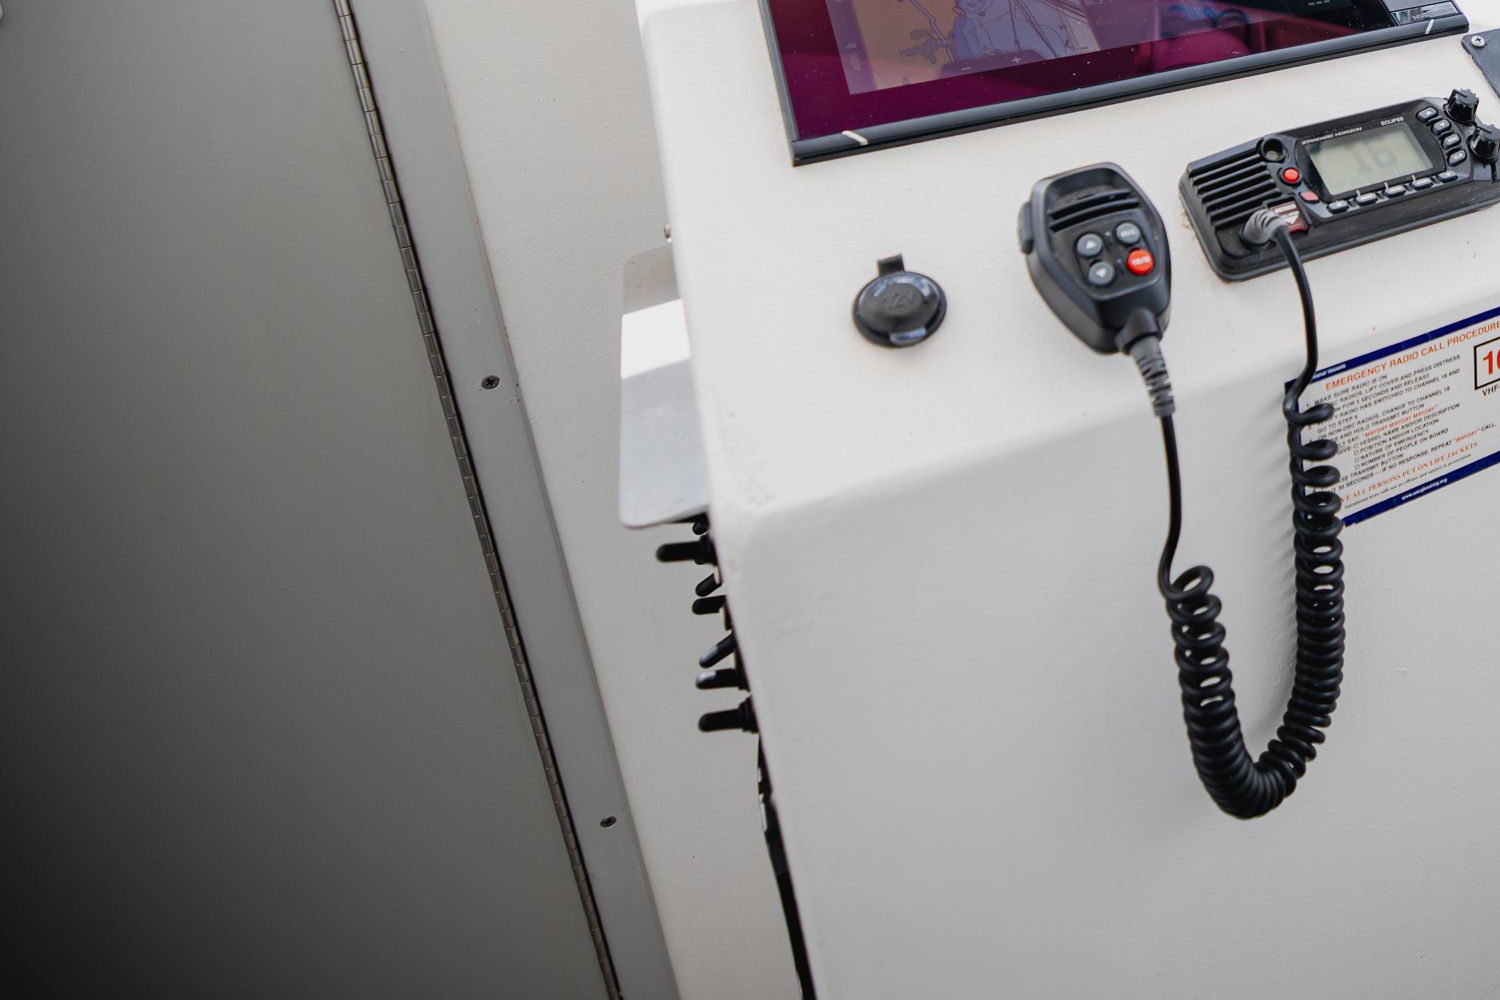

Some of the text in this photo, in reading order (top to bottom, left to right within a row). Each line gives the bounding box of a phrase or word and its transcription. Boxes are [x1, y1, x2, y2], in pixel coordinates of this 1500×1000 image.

[1301, 126, 1363, 145] STANDARD HORIZON
[1380, 116, 1405, 127] ECLIPSE
[1325, 361, 1386, 391] EMERGENCY
[1389, 350, 1418, 368] RADIO
[1420, 341, 1444, 356] CALL
[1378, 377, 1398, 389] COVER
[1413, 364, 1432, 376] PRESS
[1433, 354, 1460, 368] DISTRESS
[1314, 394, 1331, 405] MAKE
[1333, 387, 1349, 398] SURE
[1351, 380, 1370, 391] RADIO
[1339, 406, 1358, 418] RADIO
[1373, 389, 1403, 405] SWITCHED
[1413, 376, 1440, 390] CHANNEL
[1360, 387, 1388, 403] SECONDS
[1403, 372, 1429, 387] RELEASE
[1328, 422, 1355, 437] NON-DSC
[1381, 403, 1406, 416] CHANGE
[1416, 389, 1443, 403] CHANNEL
[1337, 416, 1353, 426] STEP
[1353, 424, 1369, 434] HOLD
[1371, 412, 1399, 427] TRANSMIT
[1401, 403, 1424, 416] BUTTON
[1359, 434, 1381, 446] VESSEL
[1383, 427, 1399, 437] NAME
[1400, 418, 1421, 430] AND/OR
[1423, 403, 1459, 421] DESCRIPTION
[1360, 438, 1386, 453] POSITION
[1388, 429, 1409, 442] AND/OR
[1410, 418, 1439, 433] LOCATION
[1360, 447, 1383, 460] NATURE
[1394, 429, 1429, 447] EMERGENCY
[1360, 453, 1385, 467] NUMBER
[1395, 440, 1417, 453] PEOPLE
[1428, 428, 1448, 440] BOARD
[1345, 471, 1373, 487] SECONDS
[1431, 440, 1452, 453] REPEAT
[1350, 453, 1403, 478] TRANSMIT BUTTON
[1351, 486, 1365, 498] ALL
[1368, 472, 1400, 491] PERSONS
[1402, 466, 1417, 477] PUT
[1429, 454, 1445, 467] LIFE
[1446, 441, 1478, 460] JACKETS
